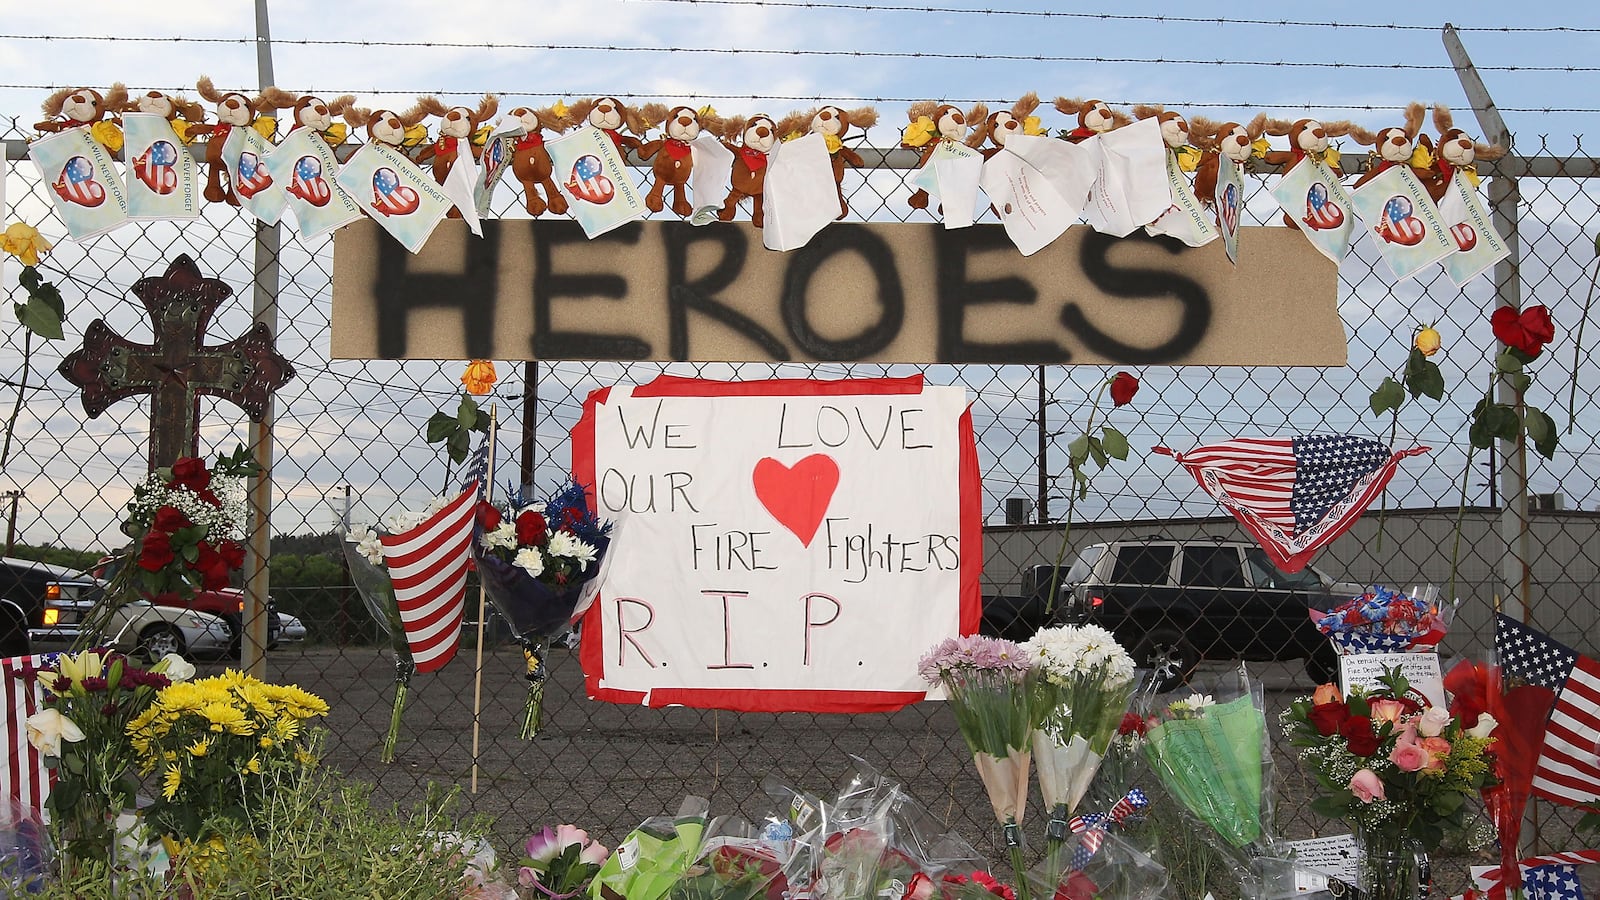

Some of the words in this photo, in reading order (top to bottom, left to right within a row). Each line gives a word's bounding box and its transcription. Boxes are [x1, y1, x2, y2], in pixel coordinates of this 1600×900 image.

[92, 145, 103, 162] WILL
[100, 164, 116, 187] NEVER
[182, 157, 191, 182] NEVER
[308, 133, 316, 143] WE
[316, 144, 328, 162] WILL
[592, 130, 602, 142] WE
[598, 142, 610, 158] WILL
[608, 158, 622, 181] NEVER
[620, 182, 638, 209] FORGET
[184, 182, 192, 212] FORGET
[374, 146, 384, 156] WE
[386, 154, 400, 168] WILL
[400, 166, 422, 184] NEVER
[421, 182, 444, 204] FORGET
[1320, 167, 1331, 184] WILL
[1330, 182, 1344, 202] NEVER
[1170, 168, 1180, 187] WILL
[1177, 186, 1192, 210] NEVER
[1190, 208, 1209, 234] FORGET
[1400, 170, 1410, 182] WE
[1408, 182, 1420, 199] WILL
[1418, 198, 1432, 220] NEVER
[1430, 220, 1450, 248] FORGET
[1460, 188, 1470, 205] WILL
[1468, 205, 1483, 228] NEVER
[1480, 226, 1500, 252] FORGET
[374, 219, 1212, 365] HEROES
[777, 402, 934, 451] LOVE
[599, 466, 701, 514] OUR
[691, 522, 779, 571] FIRE
